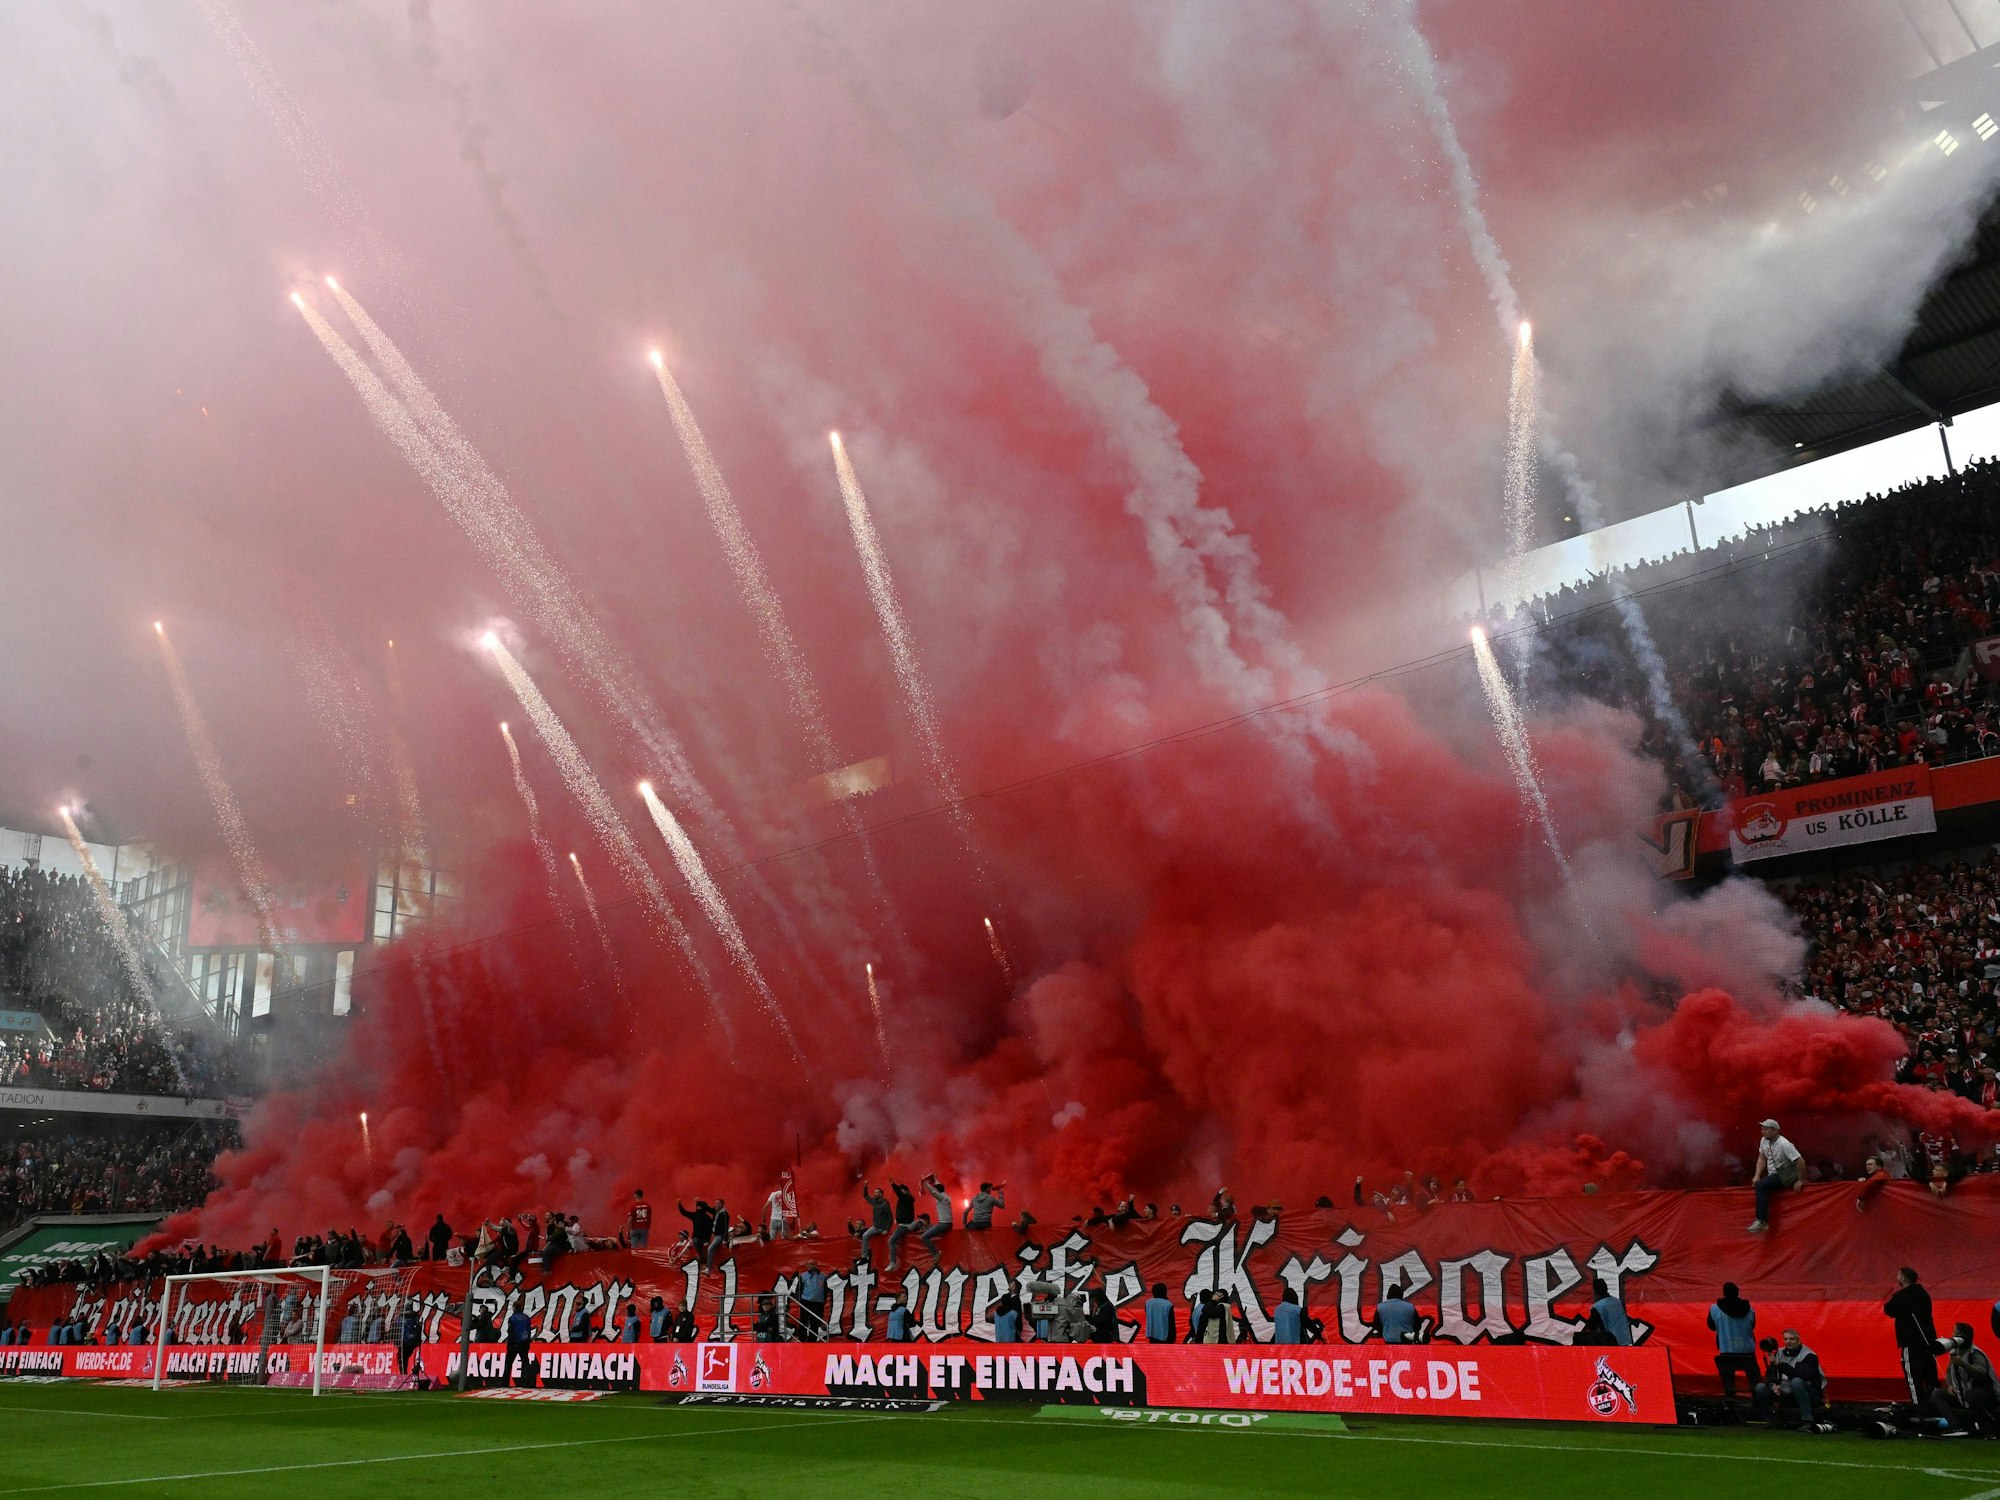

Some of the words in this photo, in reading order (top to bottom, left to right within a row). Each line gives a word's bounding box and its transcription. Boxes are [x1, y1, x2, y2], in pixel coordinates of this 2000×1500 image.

[1795, 781, 1917, 815] PROMINENZ
[1805, 821, 1828, 836] US
[1838, 804, 1909, 831] KÖLLE
[6, 1352, 18, 1369] ET
[19, 1352, 63, 1370] EINFACH
[76, 1352, 133, 1371] WERDE-FC.DE
[166, 1352, 206, 1373] MACH
[207, 1353, 226, 1374] ET
[540, 1353, 635, 1380] EINFACH
[825, 1354, 918, 1388] MACH
[930, 1355, 966, 1389] ET
[974, 1355, 1135, 1393] EINFACH
[1223, 1358, 1481, 1401] WERDE-FC.DE
